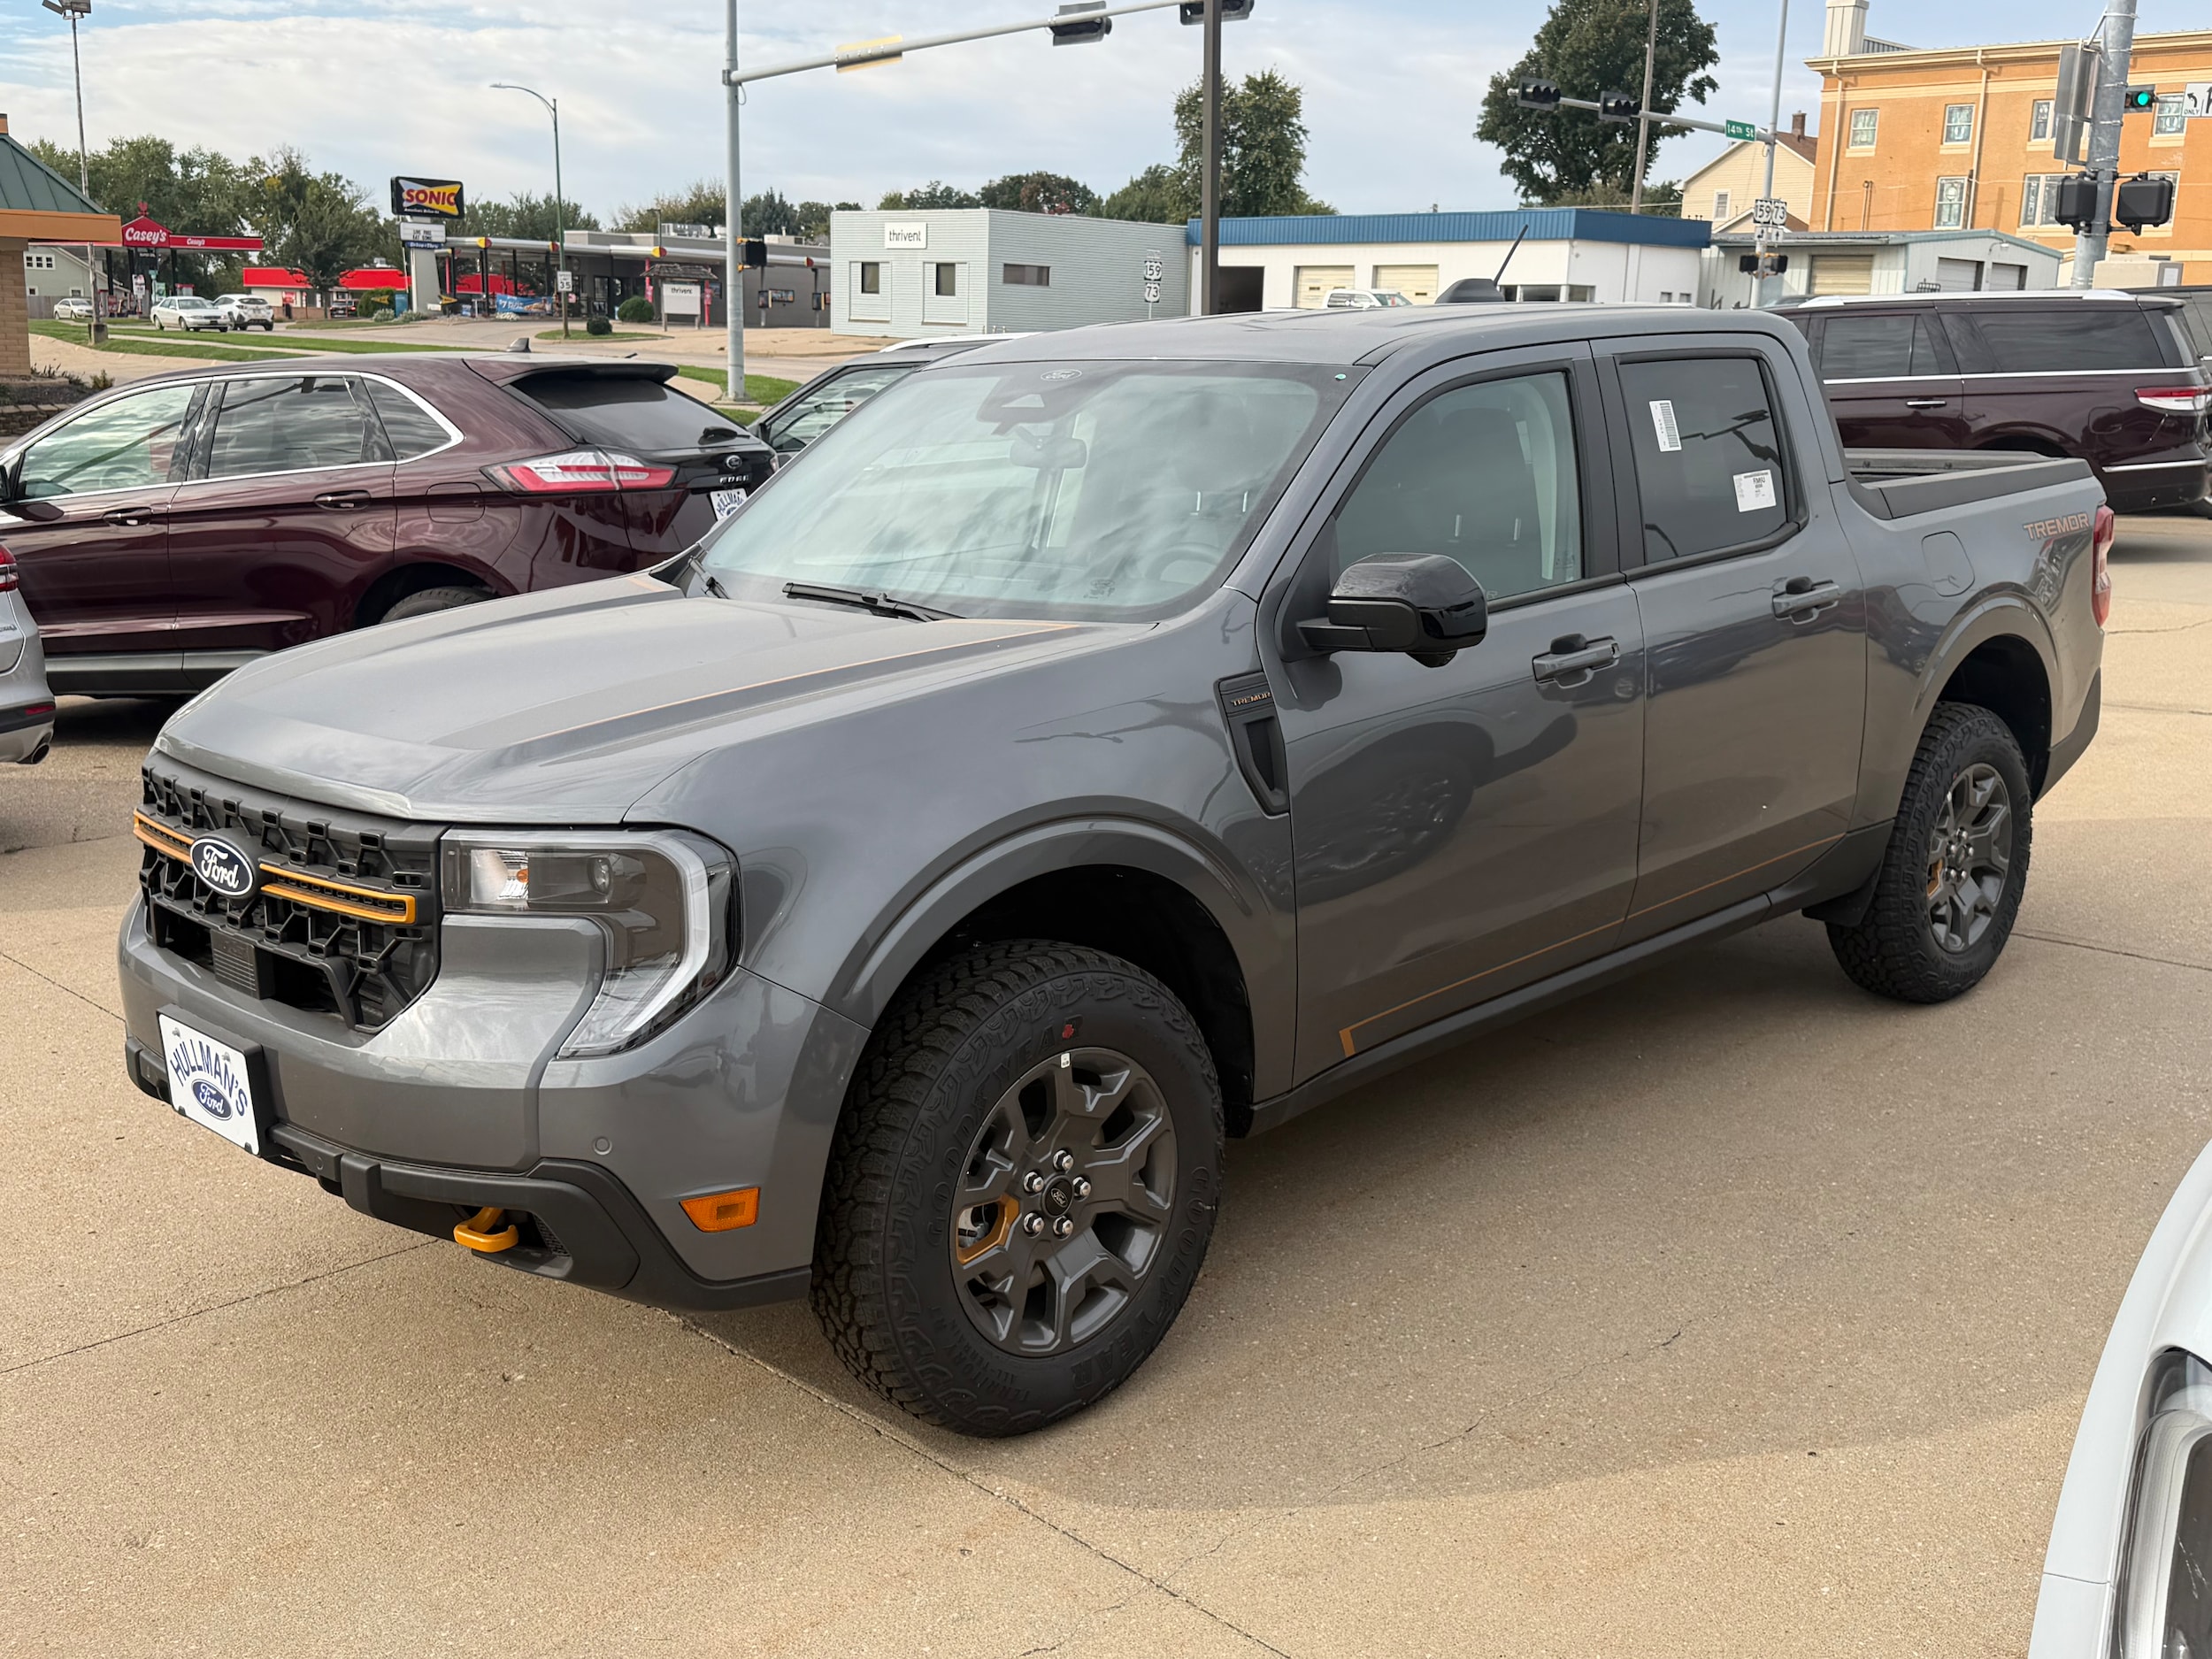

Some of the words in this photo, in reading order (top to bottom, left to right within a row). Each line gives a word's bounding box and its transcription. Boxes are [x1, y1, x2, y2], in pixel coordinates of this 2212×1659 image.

[1726, 124, 1743, 134] 14th
[1746, 128, 1754, 138] St
[405, 188, 457, 206] SONIC
[1755, 205, 1770, 219] 159
[1775, 206, 1786, 219] 73
[126, 227, 166, 244] Casey's
[889, 229, 921, 242] thrivent
[1146, 265, 1161, 276] 159
[1147, 286, 1158, 298] 73
[2024, 513, 2089, 540] TREMOR
[1231, 692, 1271, 706] TREMOR
[202, 844, 241, 889] Ford
[171, 1039, 248, 1117] HULLMAN'S
[200, 1083, 225, 1115] Ford
